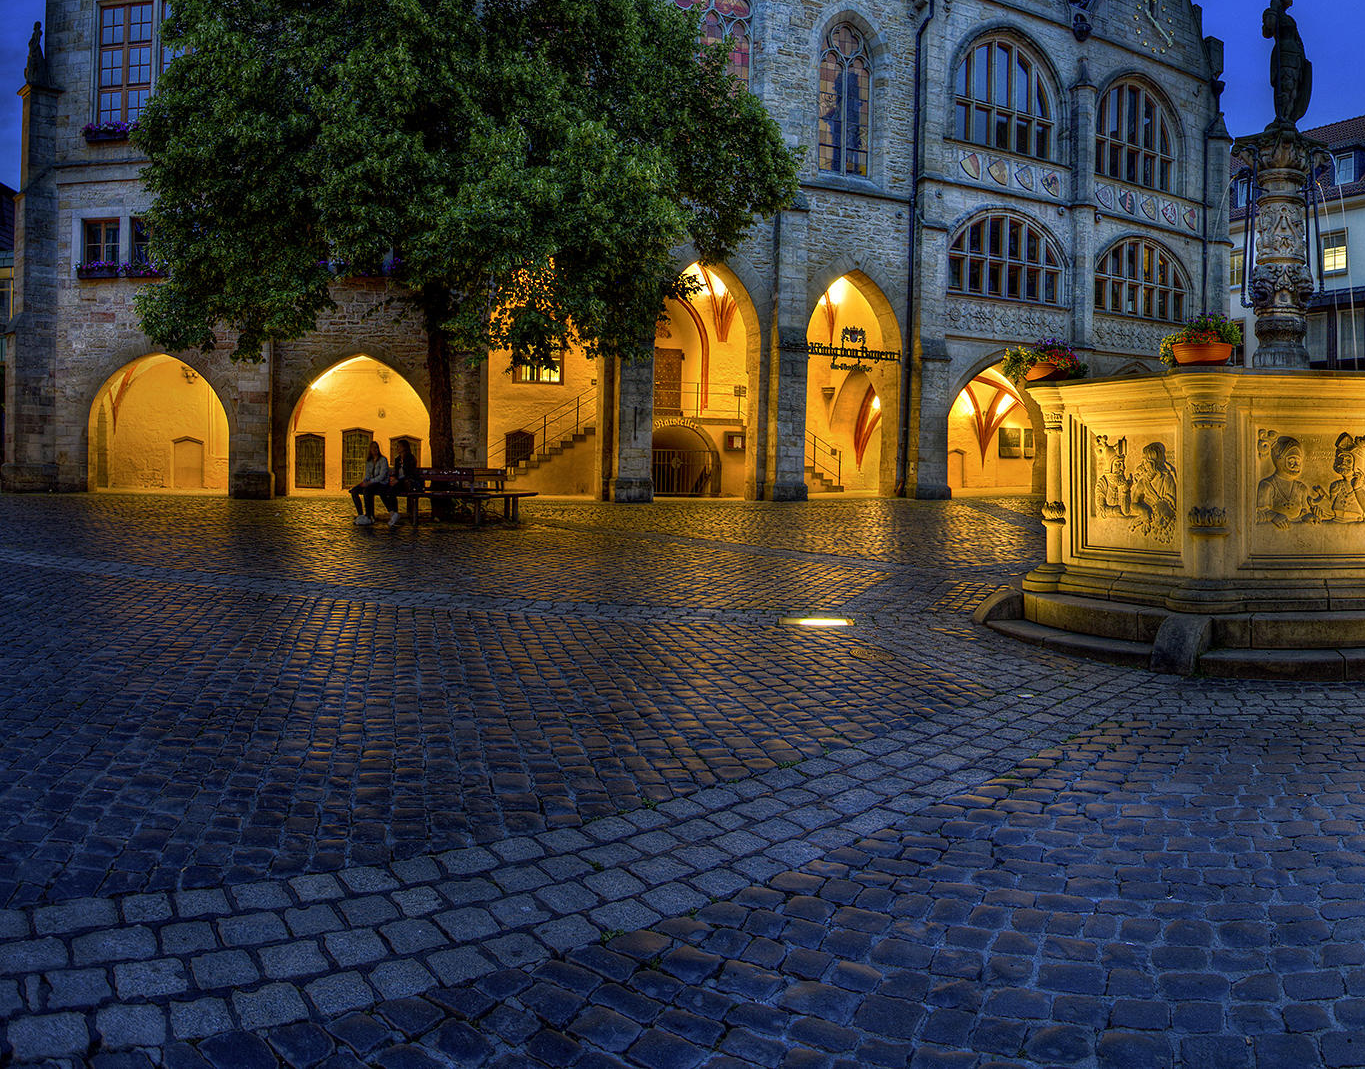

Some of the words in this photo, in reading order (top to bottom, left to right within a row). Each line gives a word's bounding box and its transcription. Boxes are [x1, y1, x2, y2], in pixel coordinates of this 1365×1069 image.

[808, 342, 839, 360] König
[860, 346, 897, 364] Bayern
[654, 418, 699, 429] Ratskeller
